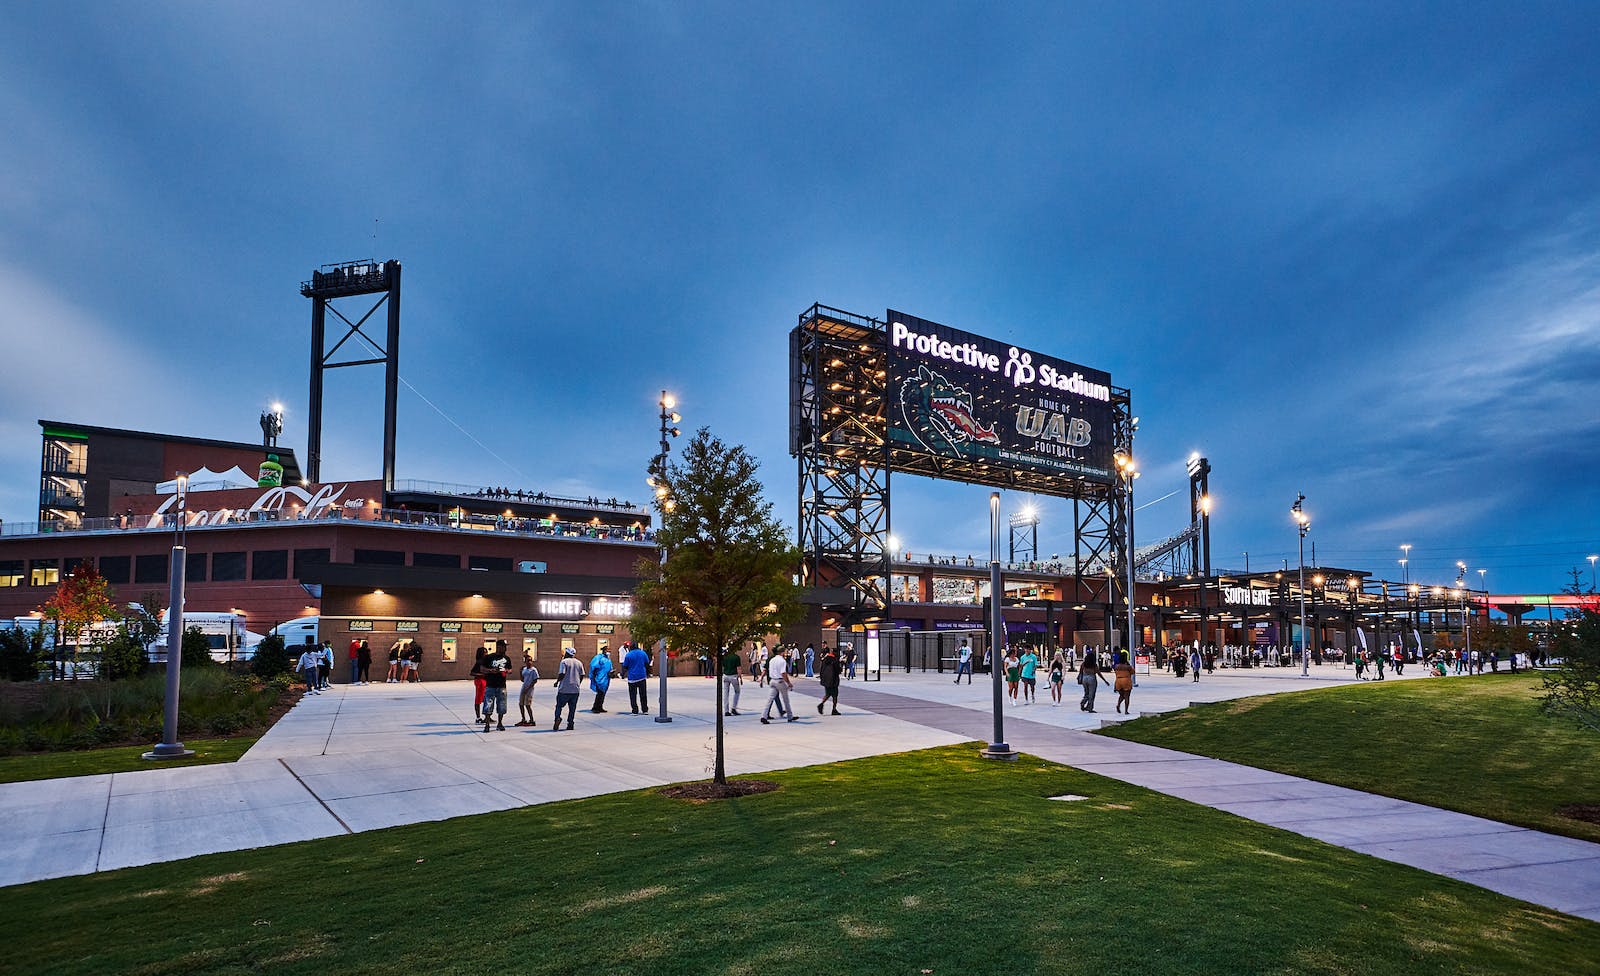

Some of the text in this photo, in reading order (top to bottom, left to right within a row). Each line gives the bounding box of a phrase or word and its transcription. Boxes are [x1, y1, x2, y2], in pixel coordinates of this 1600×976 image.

[892, 322, 1110, 402] Protective Stadium
[1039, 398, 1070, 414] HOME OF
[1015, 405, 1092, 447] UAB
[1034, 441, 1076, 459] FOOTBALL
[1224, 587, 1272, 606] SOUTH GATE
[539, 600, 632, 616] TICKET OFFICE
